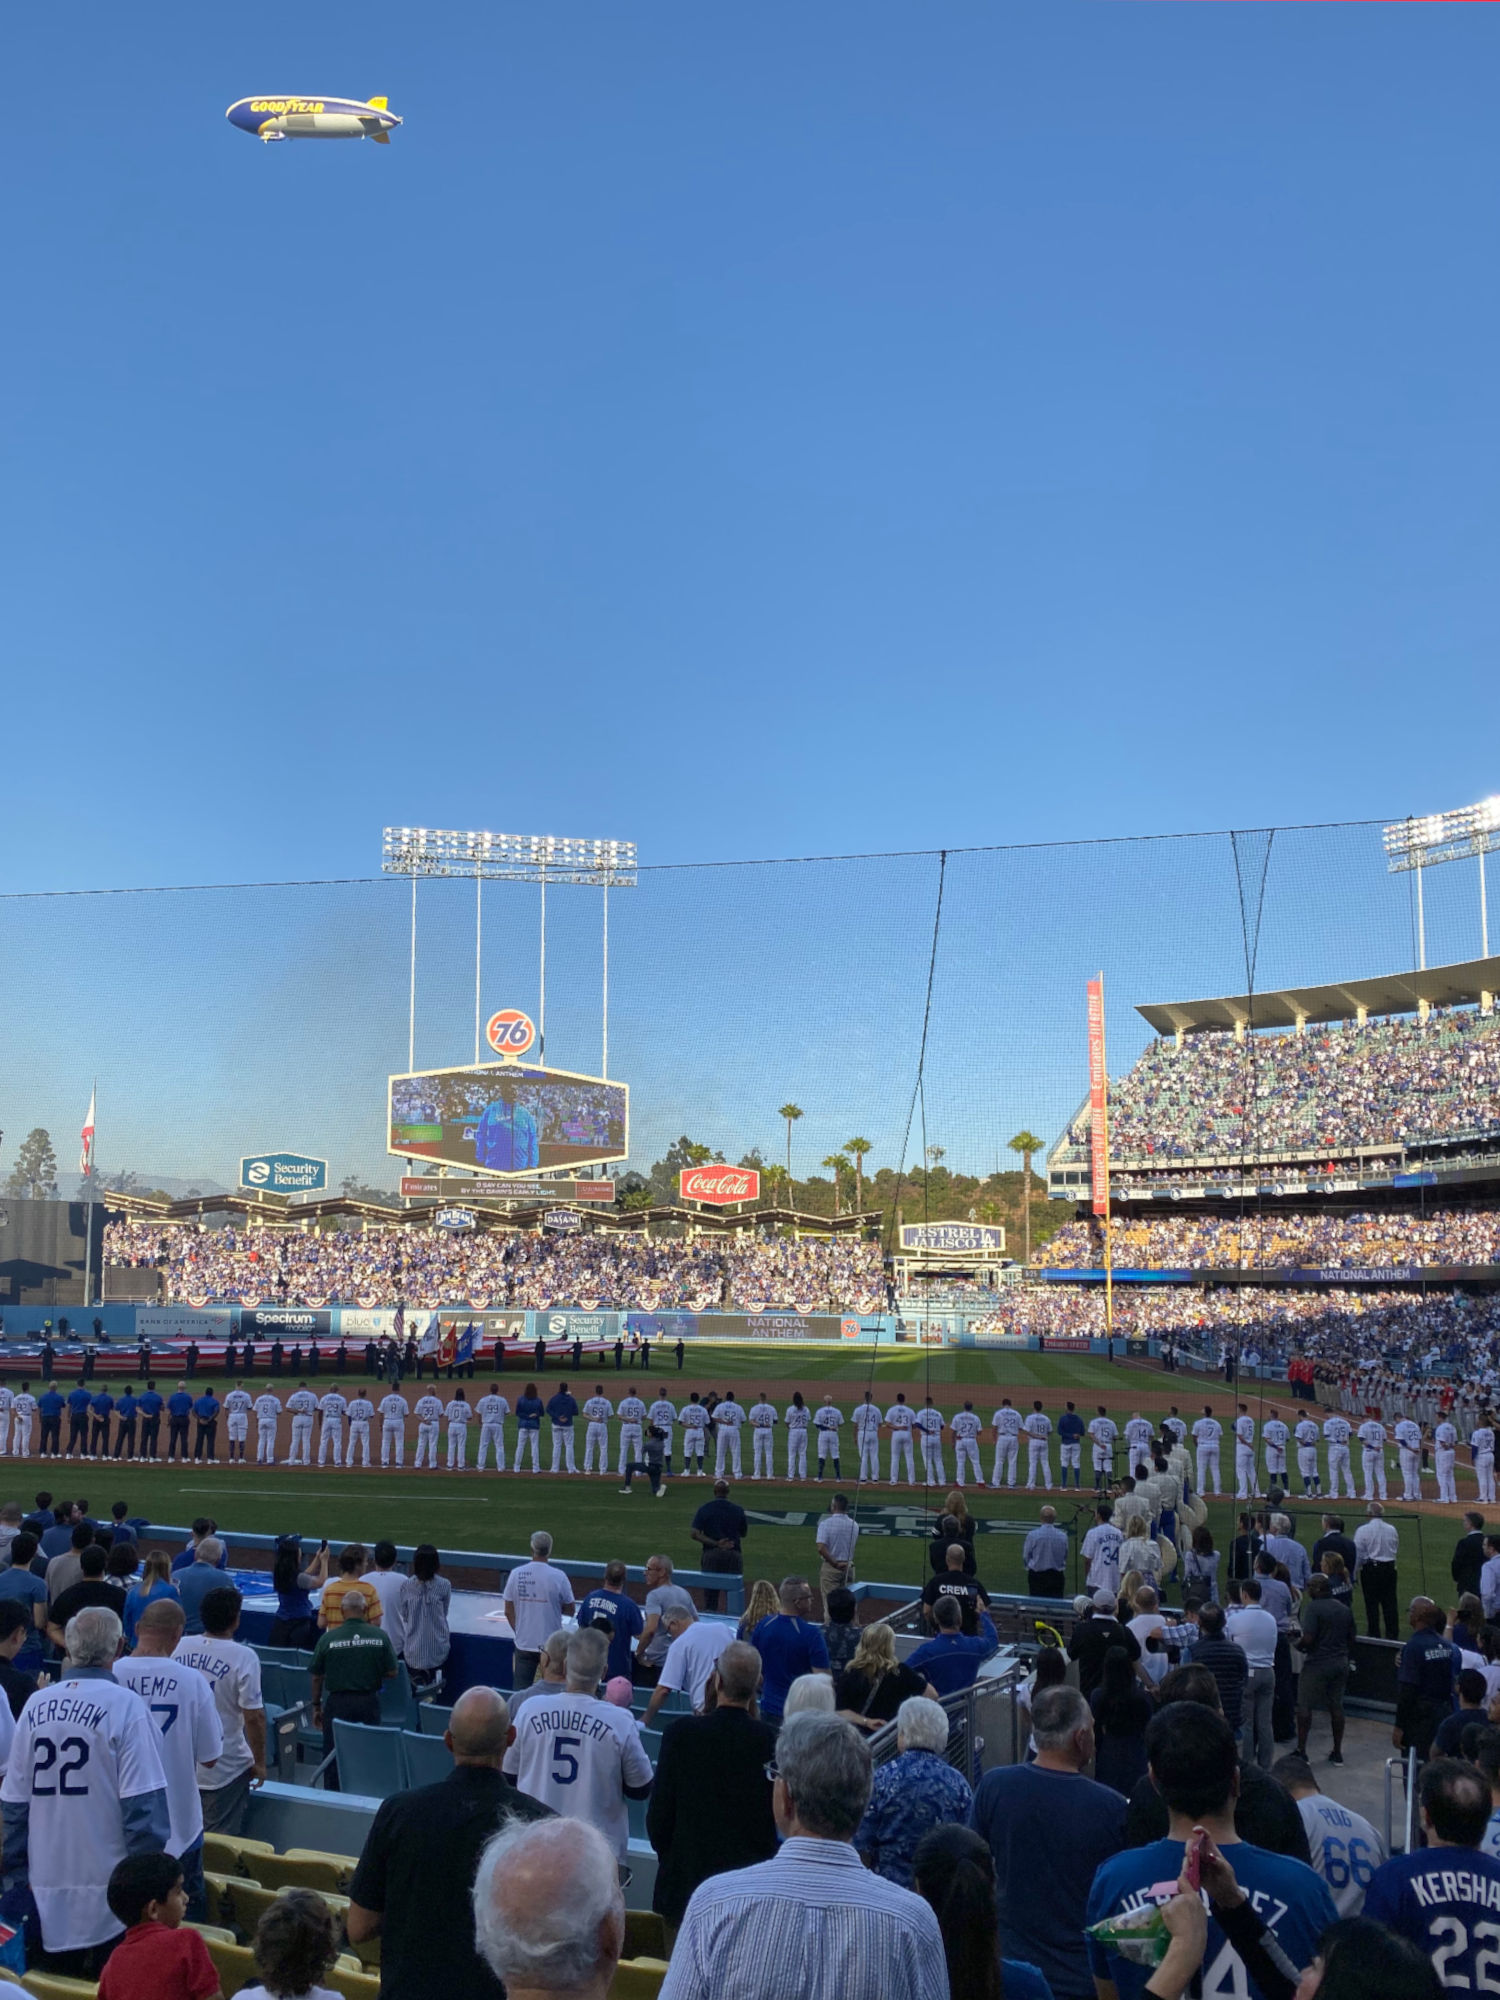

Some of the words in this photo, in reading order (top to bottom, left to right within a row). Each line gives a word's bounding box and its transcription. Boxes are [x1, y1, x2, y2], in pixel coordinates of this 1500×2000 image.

[250, 100, 325, 115] GOODYEAR
[493, 1020, 529, 1046] 76
[1090, 1039, 1103, 1090] Emirates
[273, 1162, 320, 1177] Security
[273, 1174, 313, 1186] Benefit
[1093, 1153, 1106, 1205] Emirates
[404, 1183, 438, 1192] Emirates
[547, 1215, 579, 1225] DASANI
[910, 1237, 977, 1249] JALISCO
[1320, 1270, 1370, 1281] NATIONAL
[1371, 1268, 1411, 1279] ANTHEM
[255, 1312, 313, 1326] Spectrum
[569, 1315, 605, 1327] Security
[746, 1318, 809, 1328] NATIONAL
[569, 1324, 601, 1333] Benefit
[751, 1329, 805, 1338] ANTHEM
[844, 1324, 857, 1334] 76
[231, 1400, 244, 1410] 37
[453, 1409, 459, 1418] 0
[657, 1412, 669, 1421] 56
[724, 1410, 736, 1420] 52
[823, 1416, 835, 1426] 45
[895, 1415, 909, 1425] 43
[1003, 1419, 1016, 1427] 22
[960, 1423, 973, 1433] 27
[1101, 1428, 1110, 1437] 15
[1207, 1427, 1214, 1437] 7
[1335, 1427, 1345, 1437] 35
[1137, 1429, 1147, 1438] 14
[1275, 1431, 1284, 1440] 13
[1371, 1431, 1380, 1441] 10
[1408, 1431, 1418, 1441] 25
[1102, 1546, 1120, 1566] 34
[938, 1583, 969, 1596] CREW
[588, 1597, 618, 1615] STEARNS
[329, 1639, 351, 1649] GUEST
[351, 1639, 385, 1647] SERVICES
[27, 1698, 107, 1731] KERSHAW
[150, 1703, 179, 1737] 7
[530, 1709, 613, 1742] GROUBERT
[551, 1735, 581, 1785] 5
[32, 1736, 90, 1796] 22
[1317, 1807, 1353, 1828] PUIG
[1322, 1835, 1376, 1889] 66
[1429, 1916, 1500, 1995] 22
